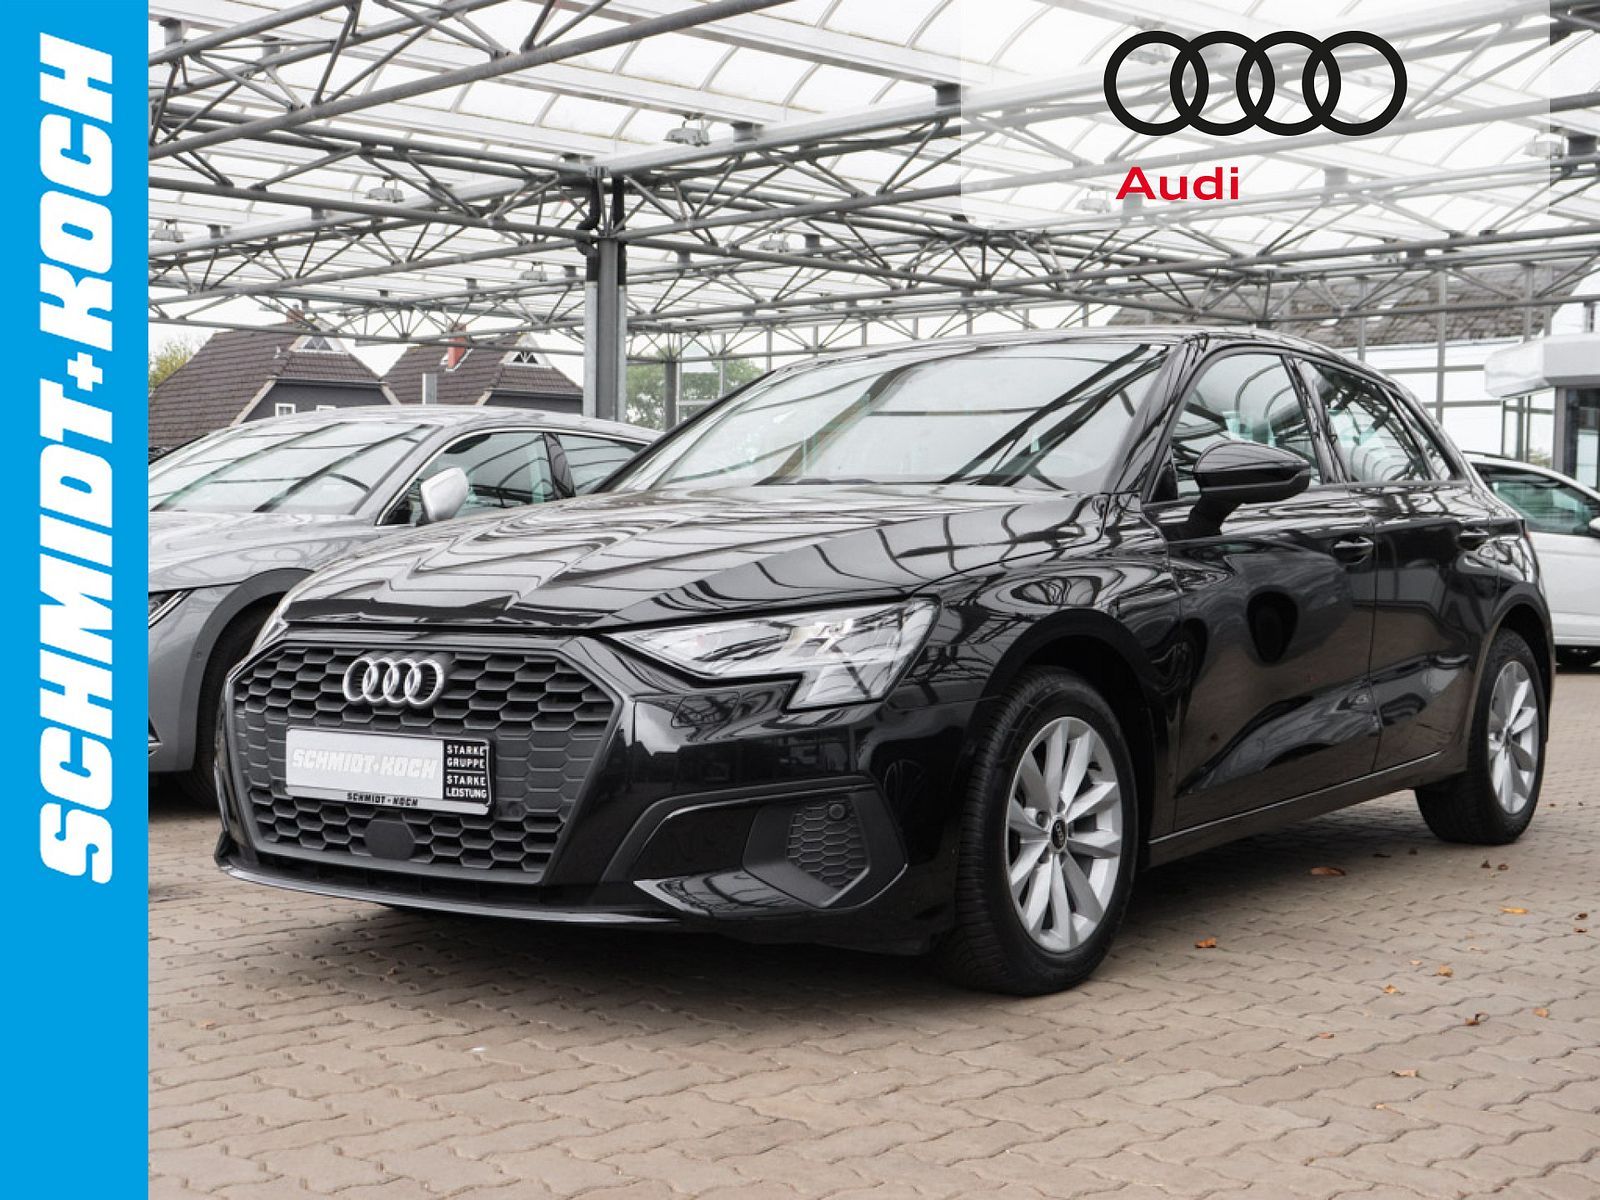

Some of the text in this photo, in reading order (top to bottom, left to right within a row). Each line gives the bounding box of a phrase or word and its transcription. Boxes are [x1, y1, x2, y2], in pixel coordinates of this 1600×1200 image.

[447, 744, 487, 756] STARKE
[447, 756, 485, 768] GRUPPE
[447, 775, 486, 786] STARKE
[446, 787, 487, 798] LEISTUNG
